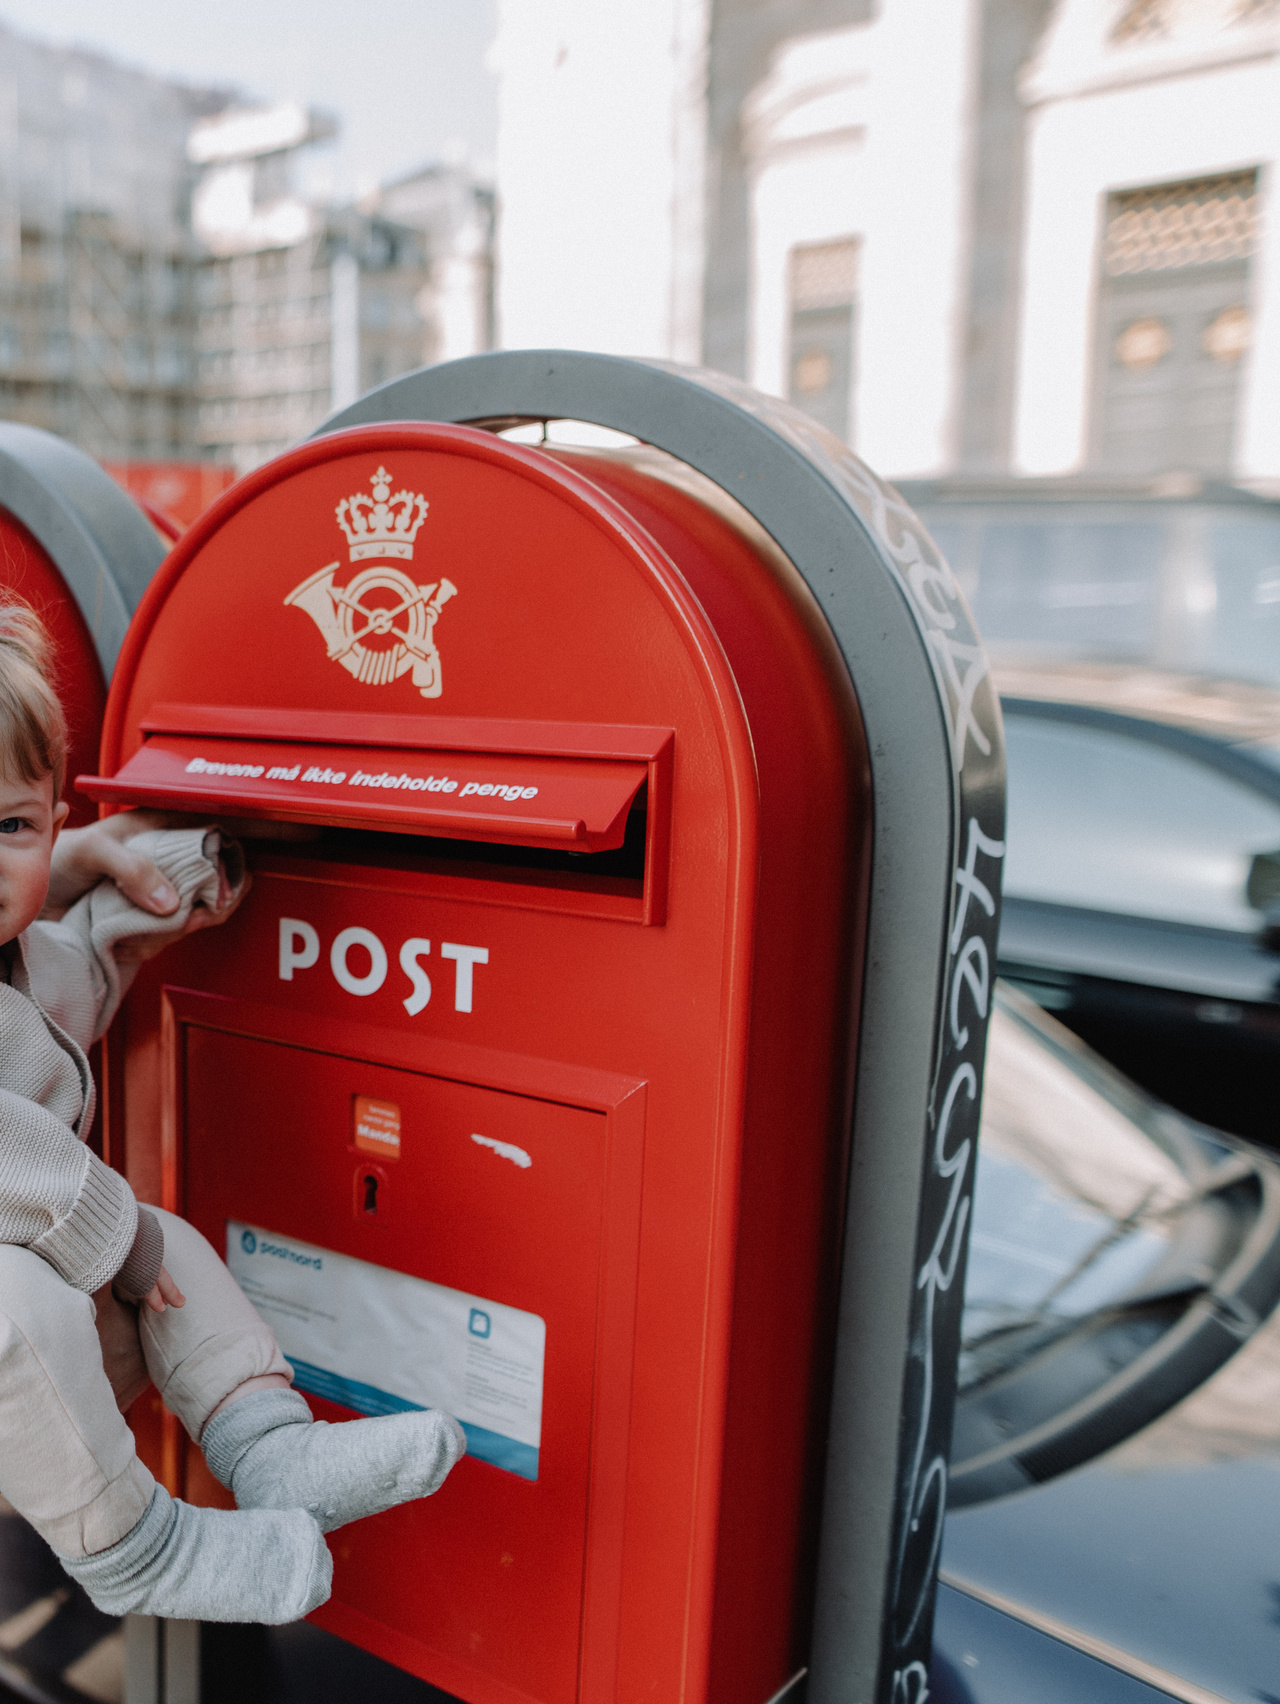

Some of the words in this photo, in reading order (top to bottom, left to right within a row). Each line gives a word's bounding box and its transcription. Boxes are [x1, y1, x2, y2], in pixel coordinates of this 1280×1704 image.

[185, 757, 265, 778] Brevene
[265, 764, 302, 781] må
[300, 766, 347, 785] ikke
[348, 770, 458, 793] indeholde
[458, 782, 539, 801] penge
[279, 917, 489, 1016] POST
